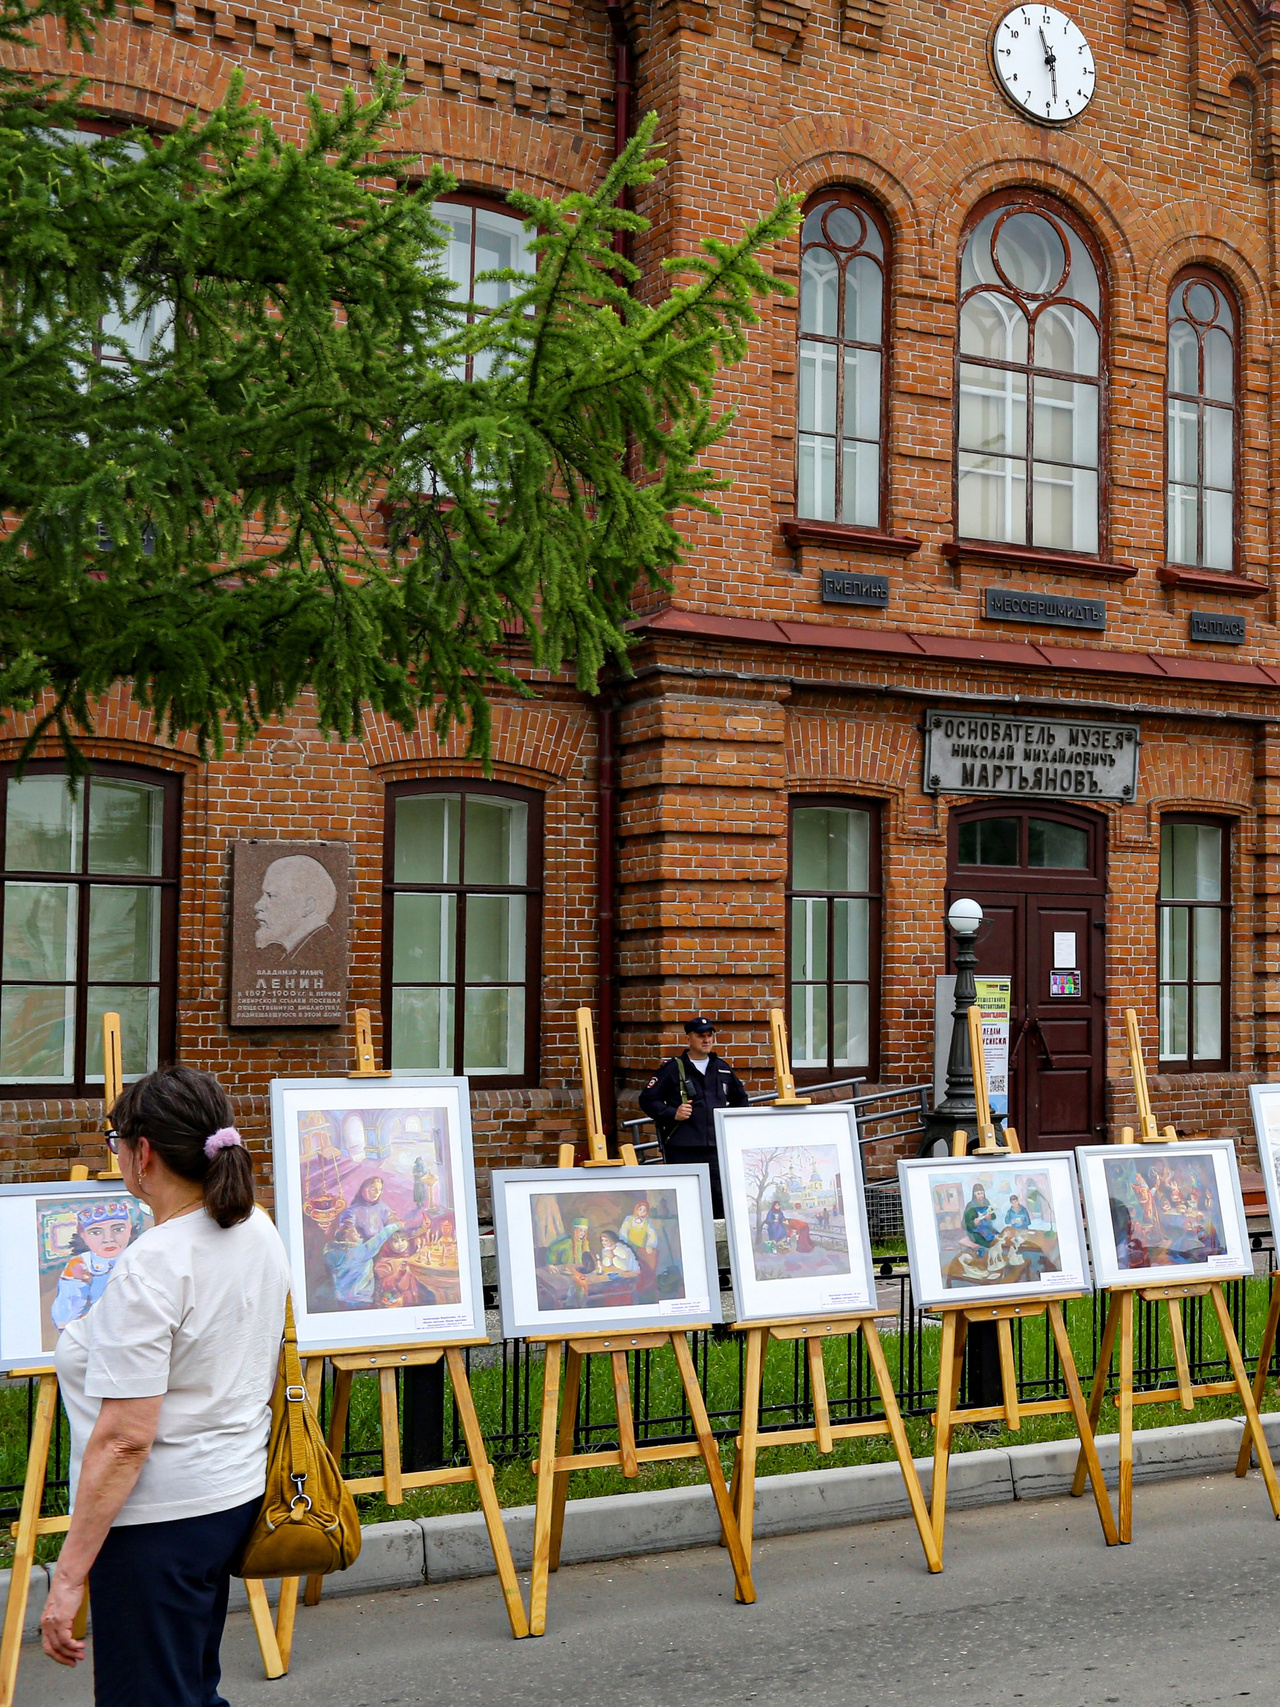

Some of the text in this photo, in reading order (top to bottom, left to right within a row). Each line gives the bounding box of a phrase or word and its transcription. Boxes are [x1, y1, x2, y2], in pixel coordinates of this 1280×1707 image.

[1024, 17, 1031, 25] 11
[1042, 15, 1051, 24] 12
[1010, 30, 1019, 38] 10
[1063, 26, 1067, 34] 1
[1006, 48, 1011, 56] 9
[1078, 46, 1083, 54] 2
[1082, 67, 1087, 75] 3
[1013, 73, 1018, 81] 8
[1026, 90, 1031, 98] 7
[1076, 88, 1082, 96] 4
[1045, 100, 1051, 108] 6
[1065, 99, 1070, 107] 5
[825, 578, 888, 598] ГМЕЛИНЪ
[993, 597, 1100, 620] МЕССЕРШМИДТЪ
[1193, 619, 1245, 636] ПАЛЛАСЪ
[944, 719, 1125, 750] ОСНОВАТЕЛЬ МУЗЕЯ
[951, 742, 1116, 767] НИКОЛАЙ МИХАЙЛОВИЧЪ
[961, 762, 1103, 794] МАРТЬЯНОВЪ.
[255, 978, 323, 989] ЛЕНИН
[982, 1027, 1001, 1035] ЛЕДАМ
